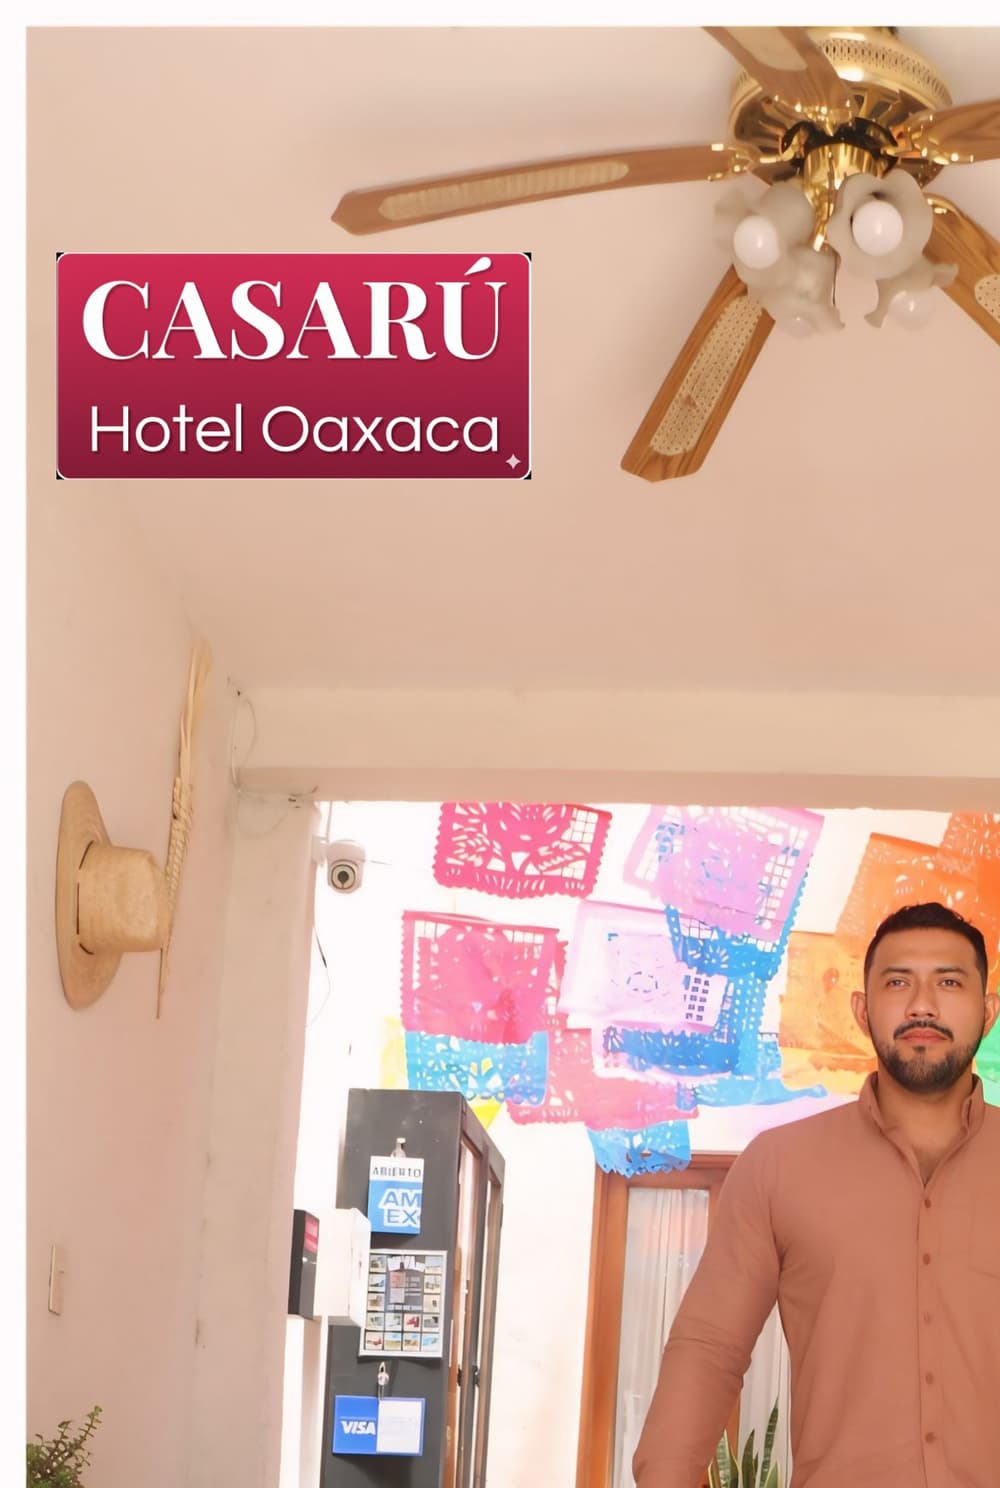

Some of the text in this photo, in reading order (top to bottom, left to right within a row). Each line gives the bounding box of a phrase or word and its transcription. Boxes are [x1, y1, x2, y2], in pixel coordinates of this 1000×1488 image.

[382, 1190, 422, 1209] AM
[386, 1208, 418, 1225] EX
[341, 1420, 377, 1435] VISA
